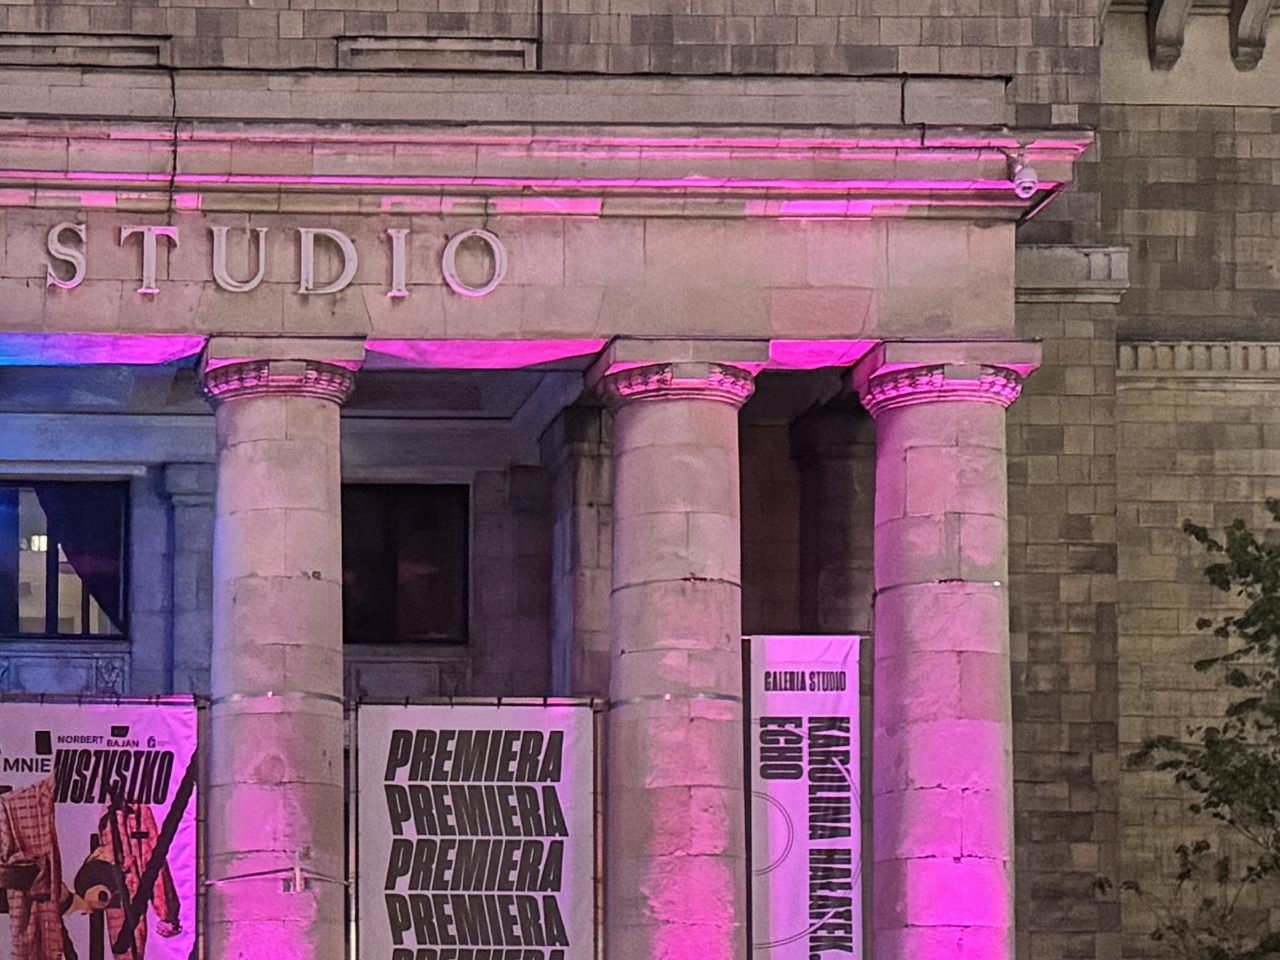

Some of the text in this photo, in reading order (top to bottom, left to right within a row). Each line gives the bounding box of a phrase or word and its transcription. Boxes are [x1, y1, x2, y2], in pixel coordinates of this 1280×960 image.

[46, 221, 508, 298] STUDIO
[764, 670, 847, 692] GALERIA STUDIO
[57, 735, 105, 744] NORBERT
[106, 739, 140, 748] BAJAN
[384, 729, 564, 782] PREMIERA
[759, 716, 804, 780] ECHO
[3, 757, 52, 773] MNIE
[53, 749, 175, 805] WSZYSTKO
[808, 716, 852, 841] KAROLINA
[384, 784, 569, 837] PREMIERA
[384, 838, 564, 892] PREMIERA
[384, 893, 569, 947] PREMIERA
